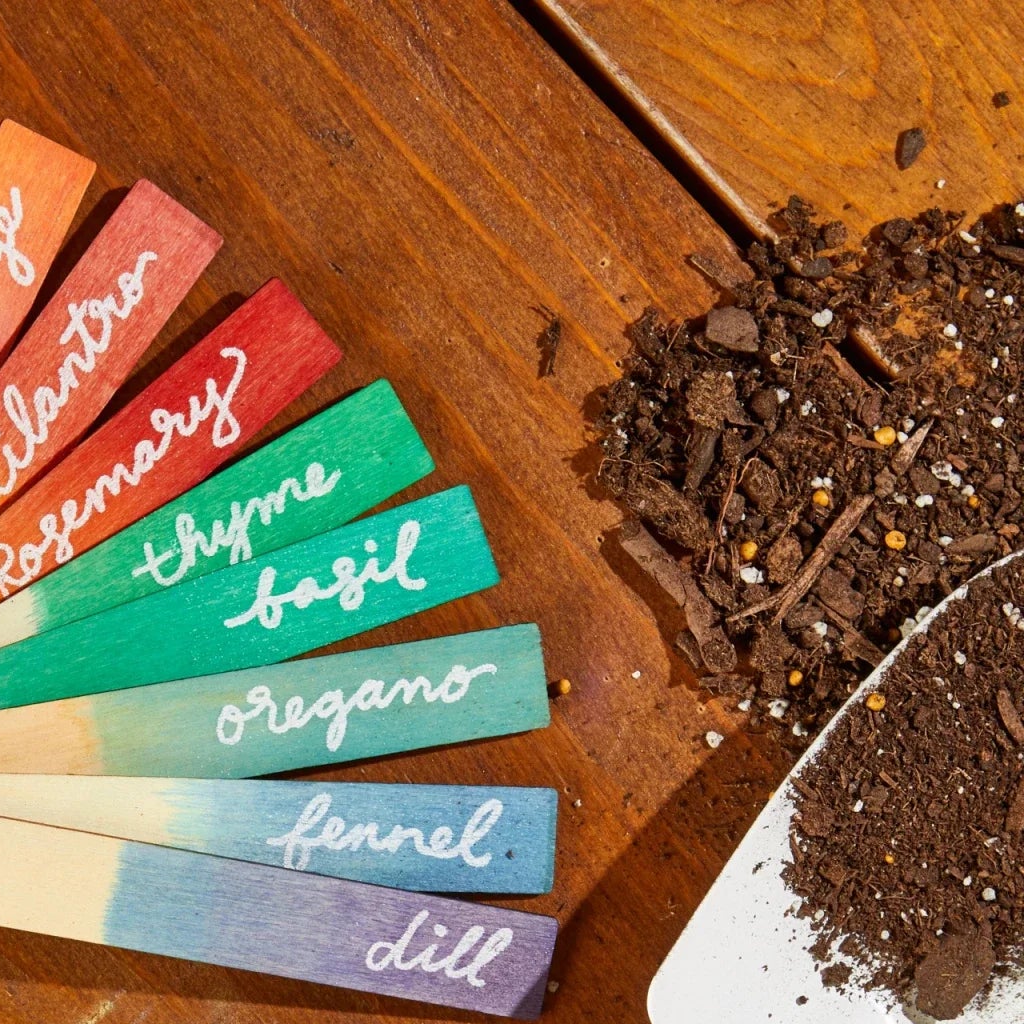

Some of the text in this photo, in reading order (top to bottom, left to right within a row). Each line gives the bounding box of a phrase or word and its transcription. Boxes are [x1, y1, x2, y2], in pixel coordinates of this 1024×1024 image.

[132, 463, 341, 586] thyme
[225, 519, 426, 629] basil
[216, 663, 498, 751] oregano
[268, 794, 503, 870] fennel
[365, 911, 513, 988] dill
